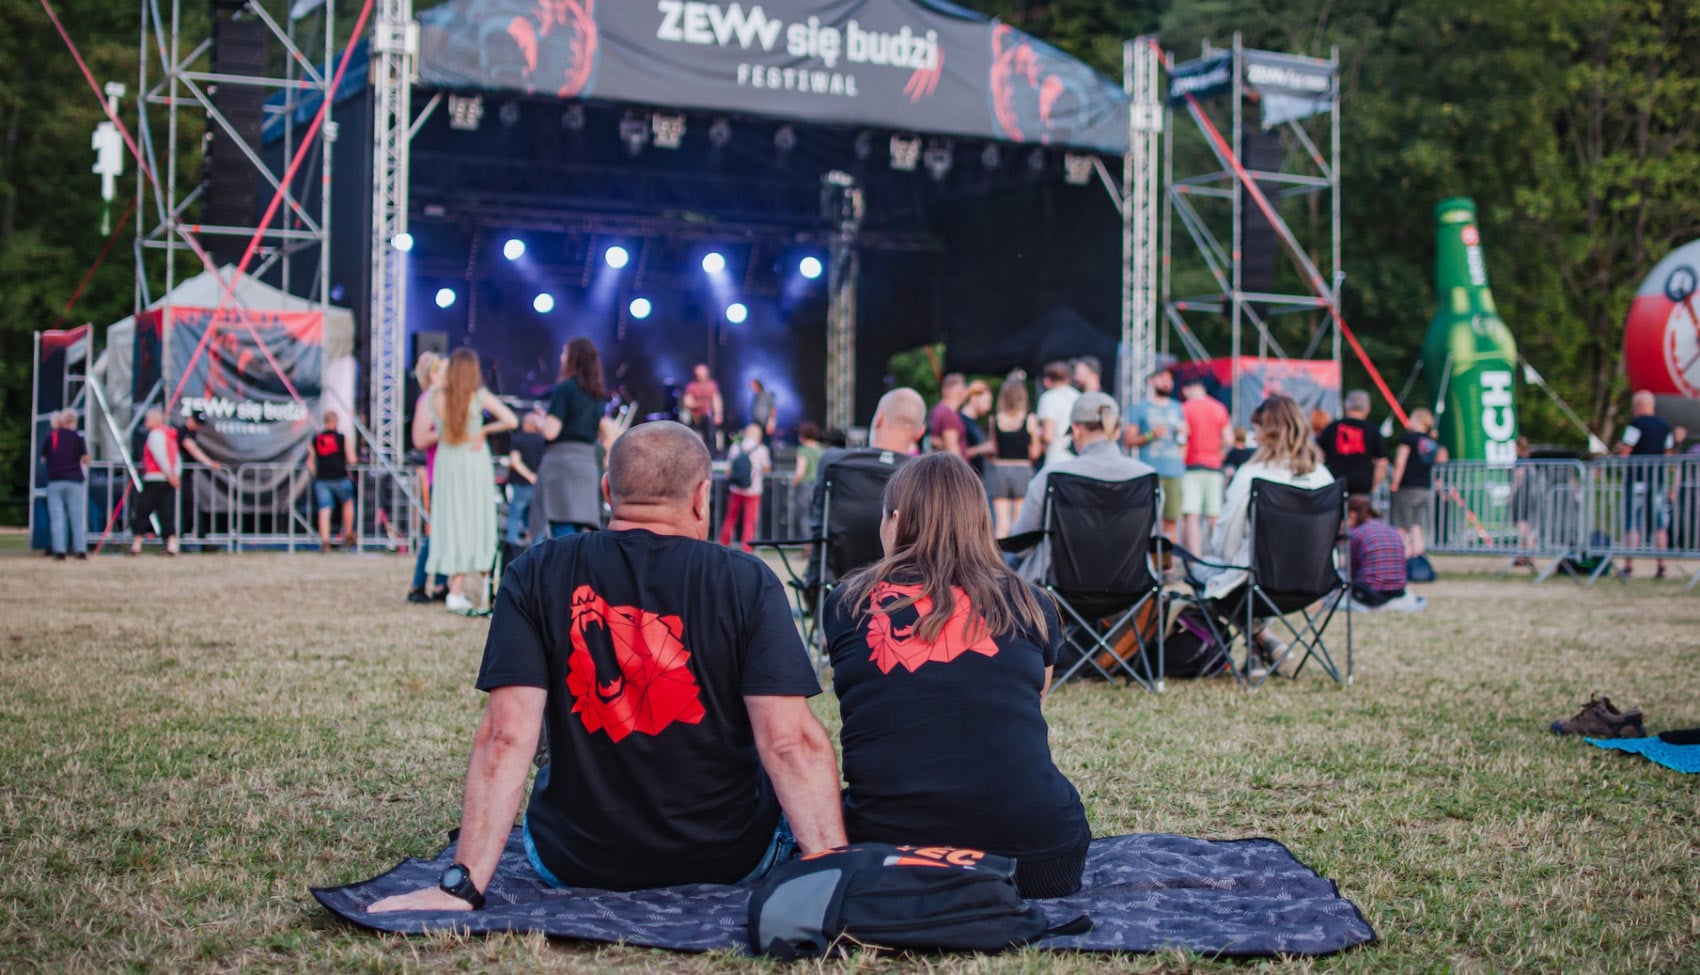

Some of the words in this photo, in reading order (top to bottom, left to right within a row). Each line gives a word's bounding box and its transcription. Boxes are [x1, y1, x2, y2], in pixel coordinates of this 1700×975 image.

[786, 16, 841, 68] się
[847, 20, 939, 71] budzi
[737, 63, 858, 97] FESTIWAL
